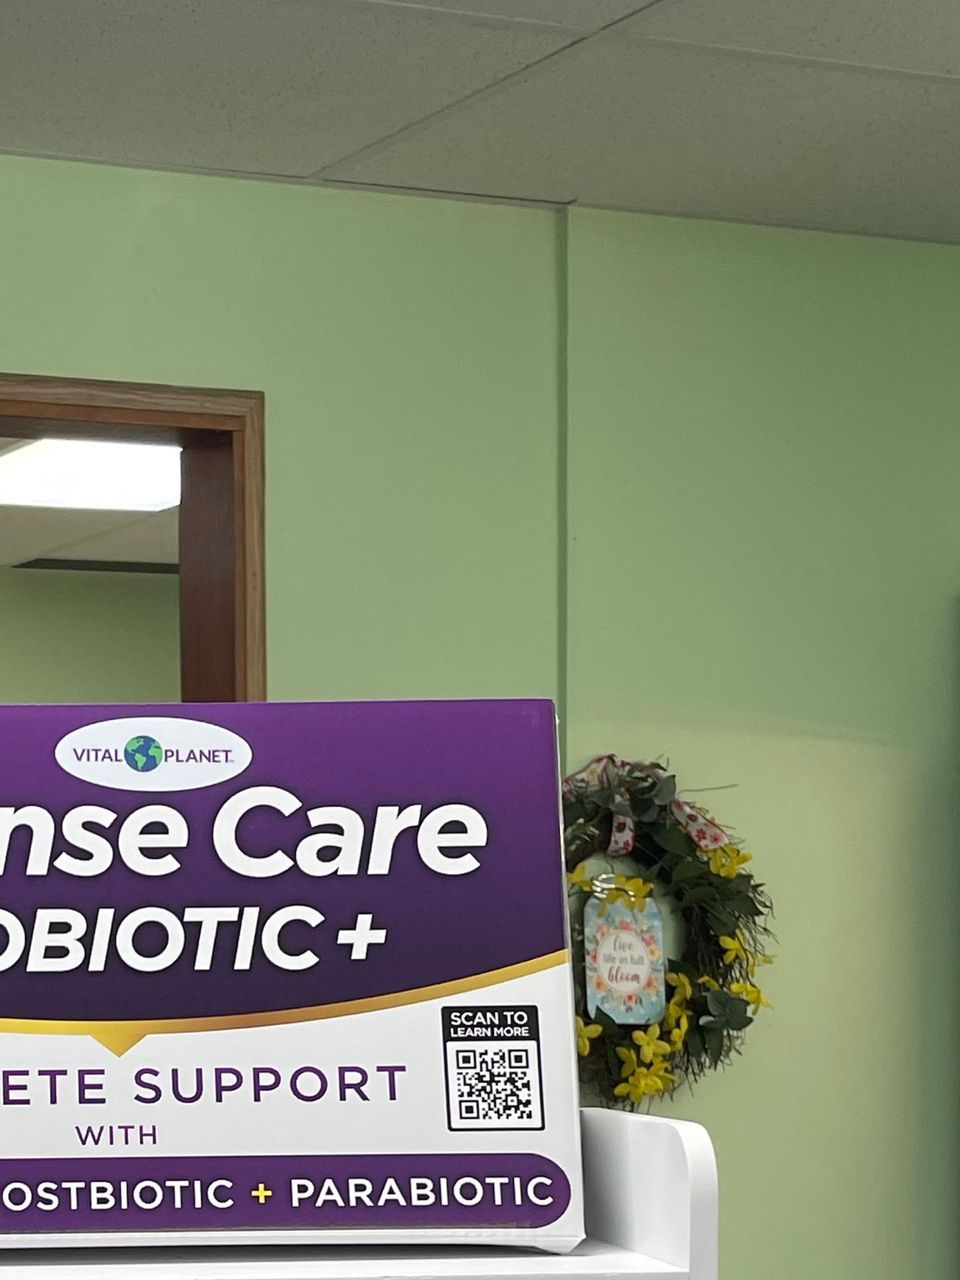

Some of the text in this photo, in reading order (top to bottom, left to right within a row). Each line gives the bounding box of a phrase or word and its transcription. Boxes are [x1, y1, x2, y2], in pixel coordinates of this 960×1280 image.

[73, 747, 231, 763] VITAL PLANET
[213, 785, 489, 878] Care
[450, 1011, 528, 1026] SCAN TO
[450, 1026, 530, 1038] LEARN MORE
[134, 1065, 406, 1104] SUPPORT
[75, 1125, 157, 1146] WITH
[290, 1177, 554, 1208] PARABIOTIC
